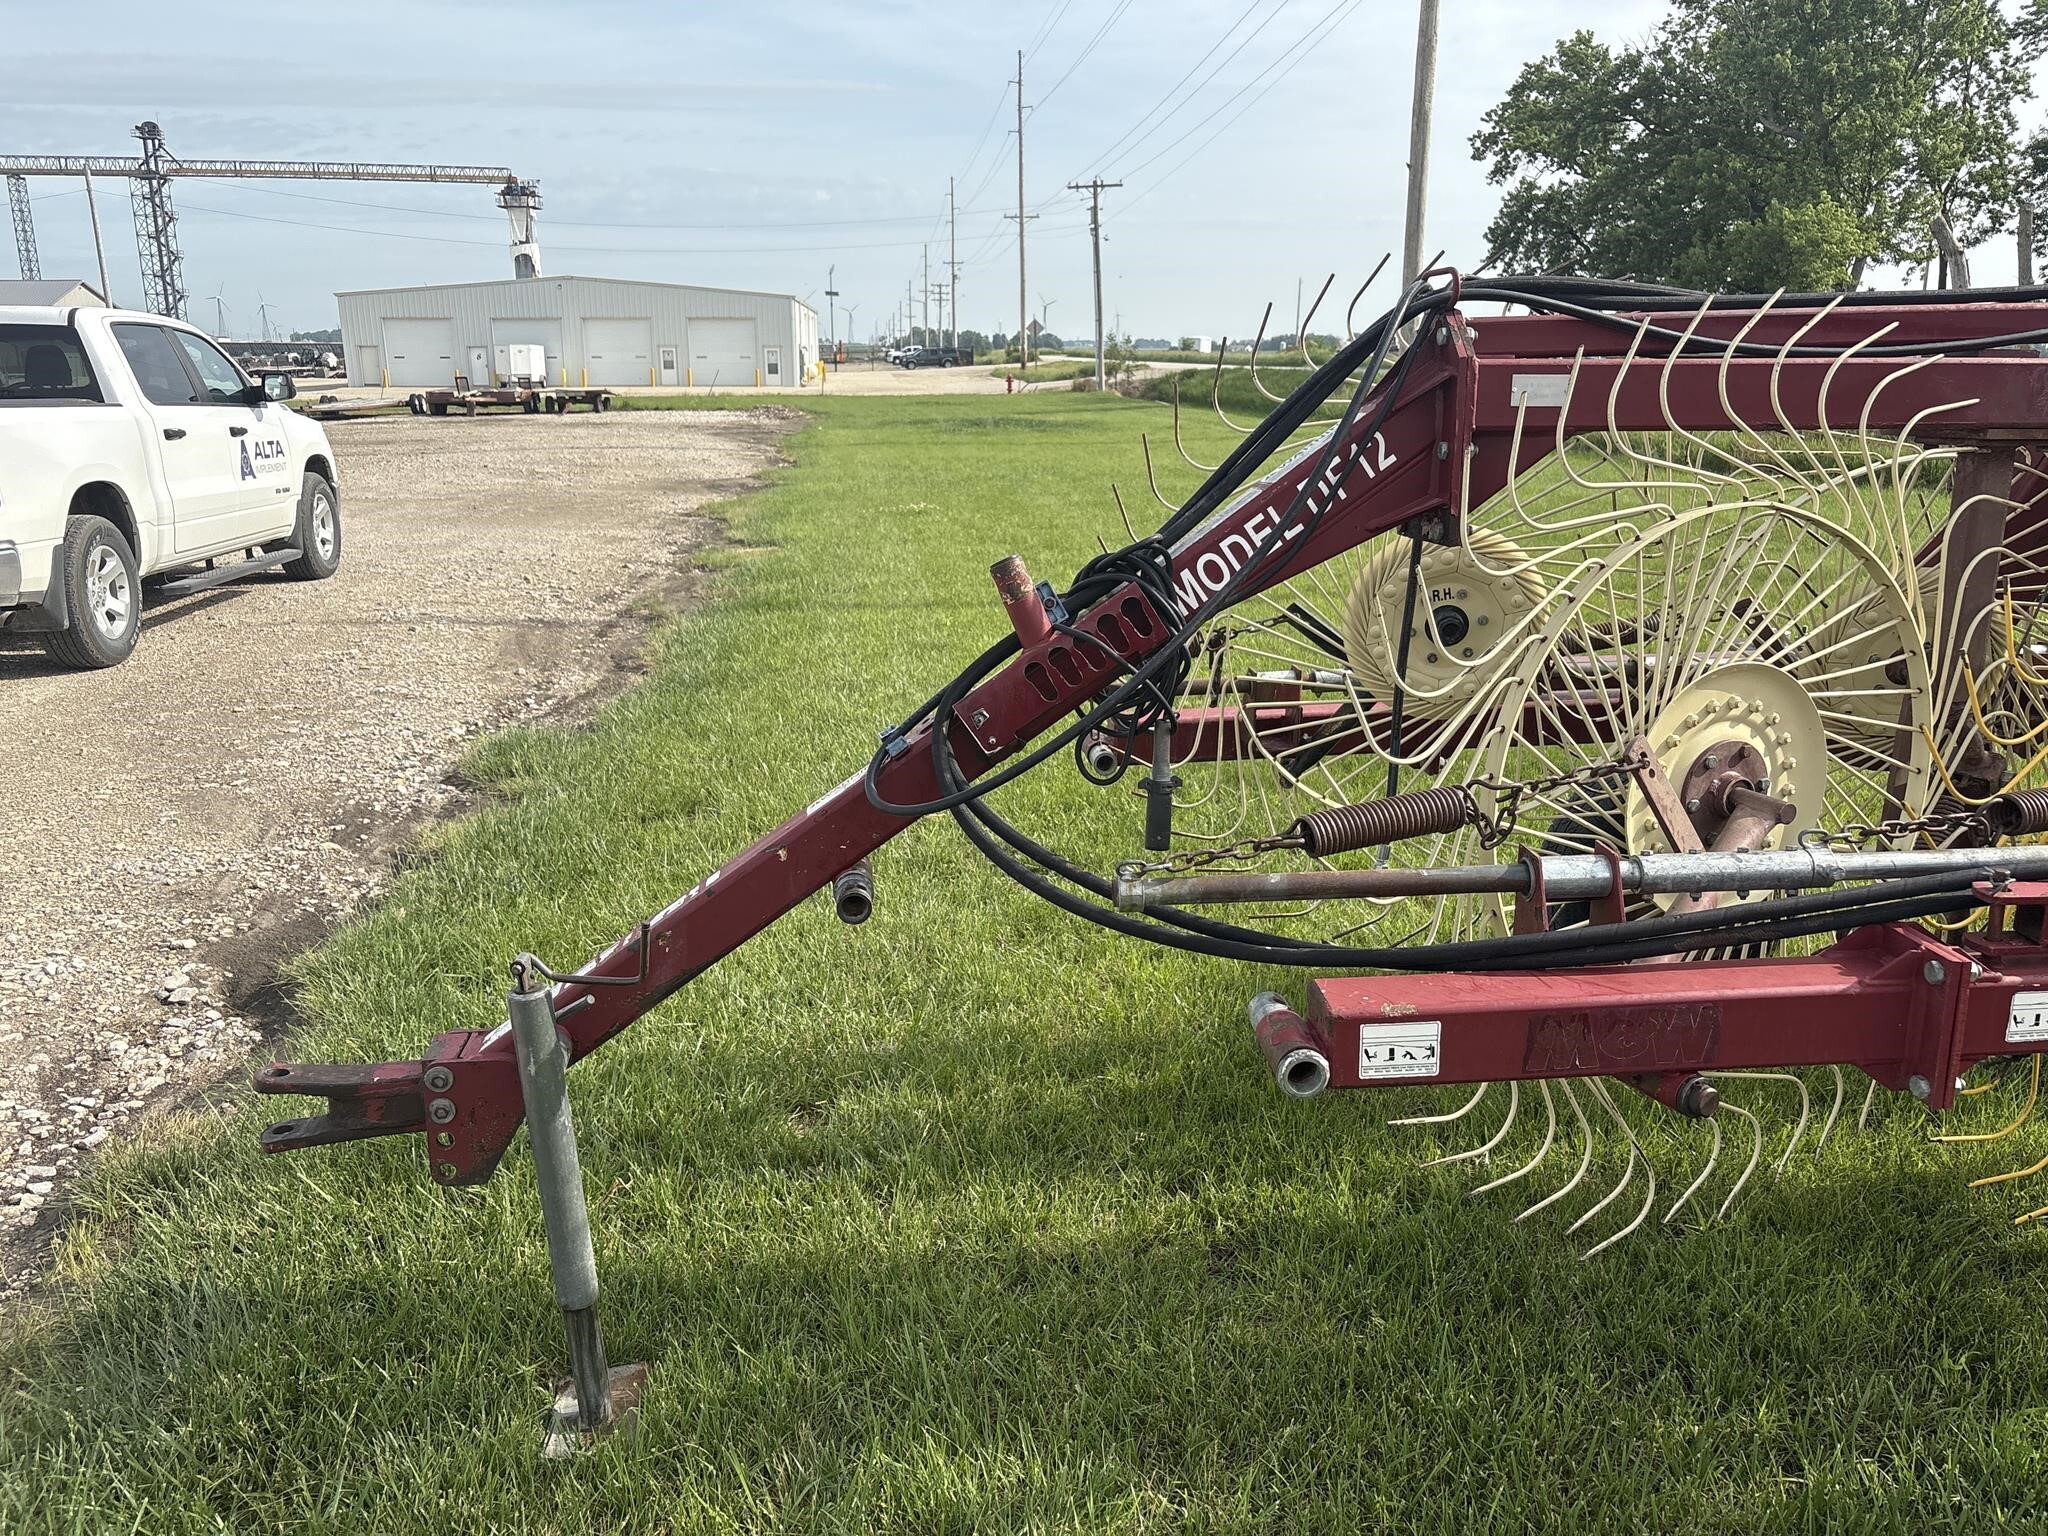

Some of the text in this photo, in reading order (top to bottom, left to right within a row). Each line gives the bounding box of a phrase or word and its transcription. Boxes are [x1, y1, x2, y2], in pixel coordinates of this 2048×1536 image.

[254, 440, 285, 460] ALTA
[1173, 505, 1305, 617] MODEL
[1432, 587, 1455, 602] R.H.
